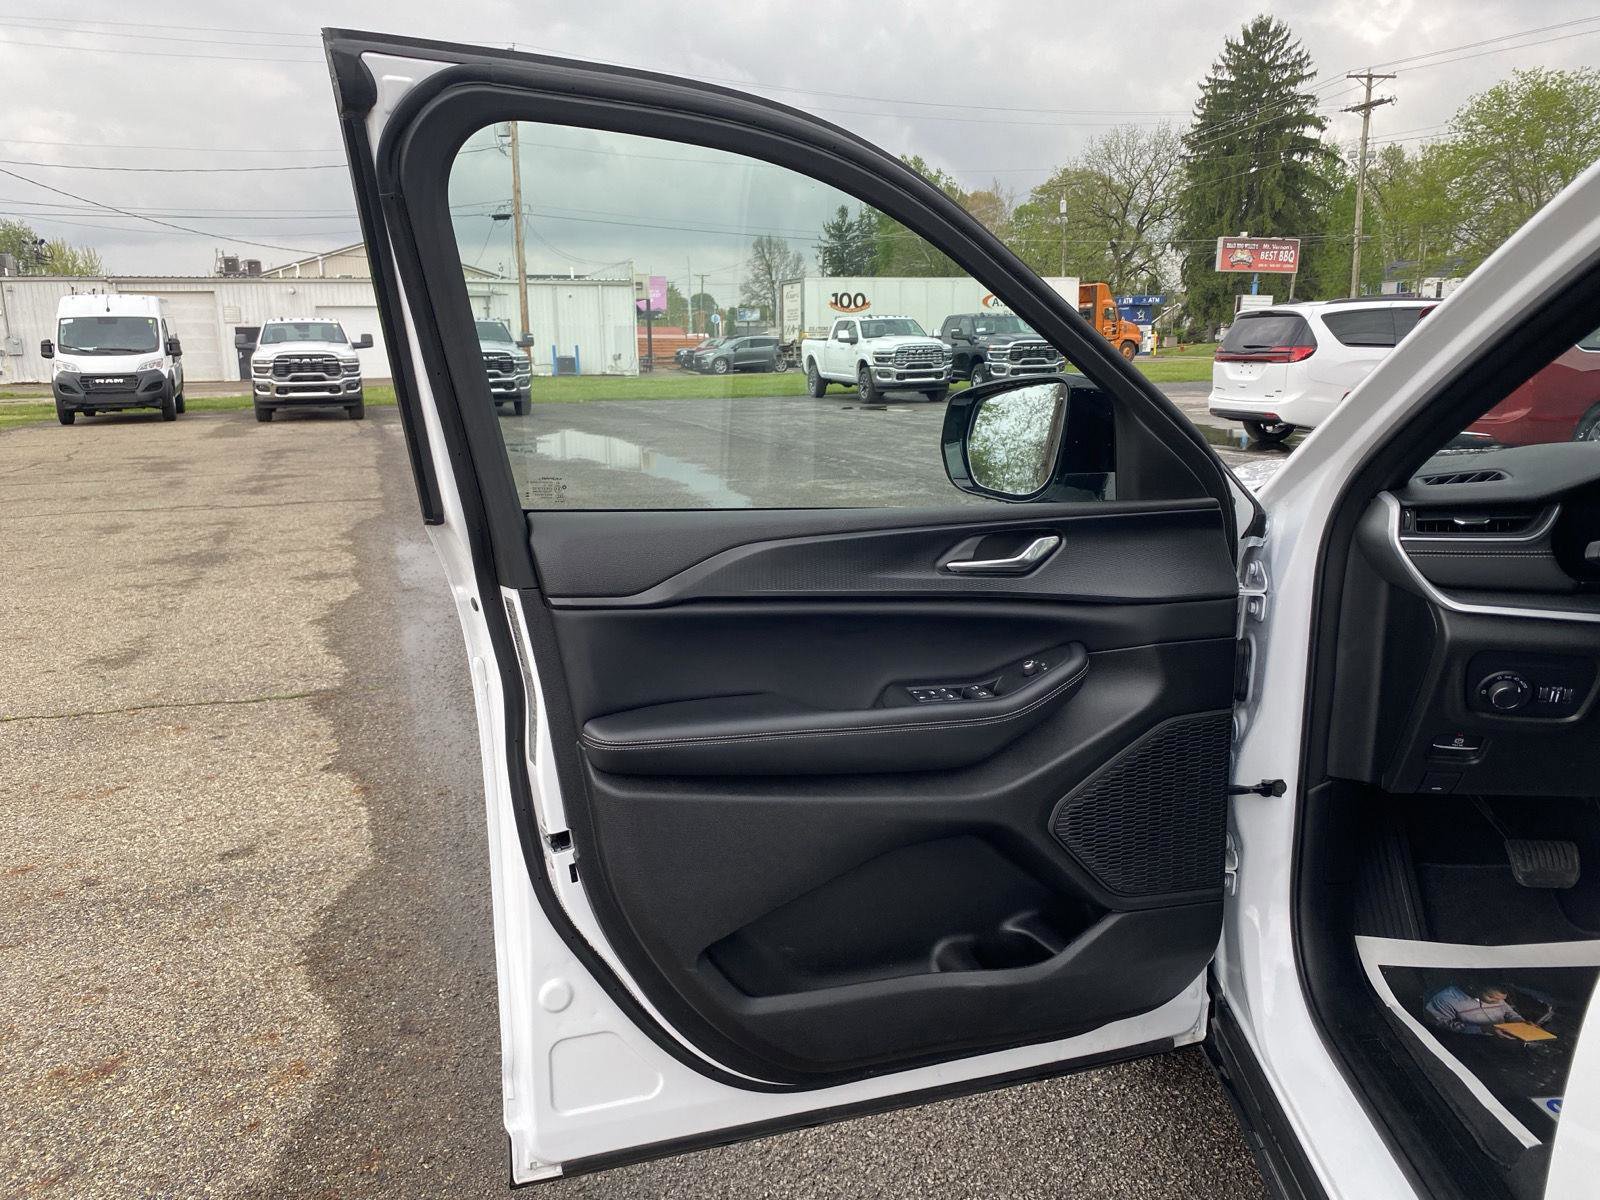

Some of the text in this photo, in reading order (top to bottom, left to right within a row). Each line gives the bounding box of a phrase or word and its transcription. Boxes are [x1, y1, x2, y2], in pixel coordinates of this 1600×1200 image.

[1260, 250, 1295, 263] BEST BBQ
[832, 292, 866, 308] 100
